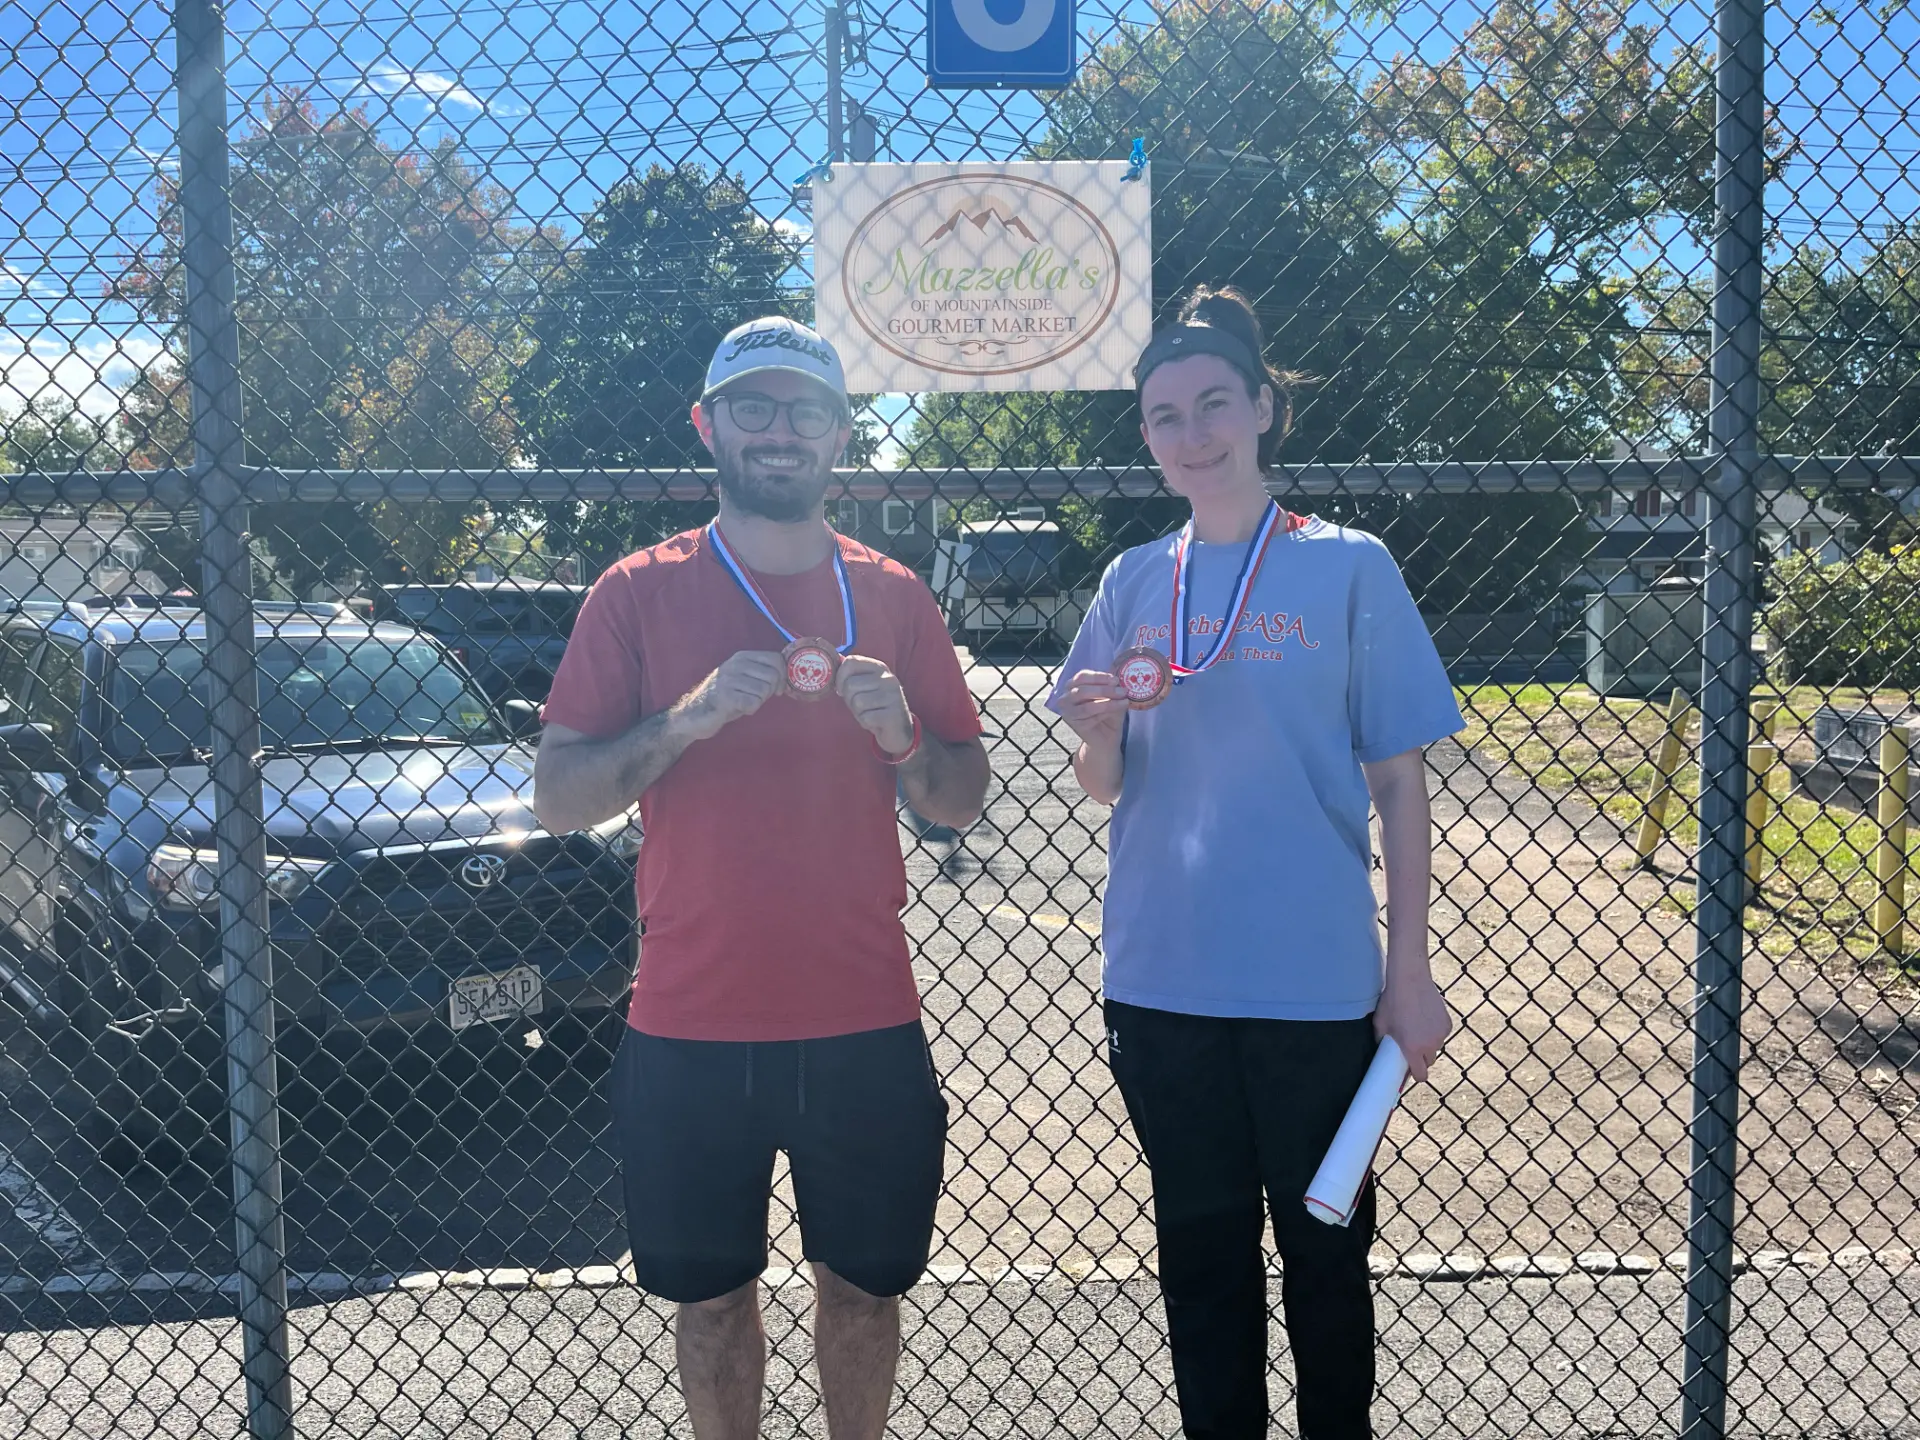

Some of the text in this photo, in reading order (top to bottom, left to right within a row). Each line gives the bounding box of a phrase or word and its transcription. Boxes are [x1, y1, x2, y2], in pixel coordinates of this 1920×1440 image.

[863, 247, 1099, 296] Mazzella's
[911, 298, 1053, 312] OF MOUNTAINSIDE
[887, 316, 1077, 335] GOURMET MARKET
[724, 327, 832, 366] Titleist
[1136, 623, 1172, 647] Roc
[1188, 613, 1225, 635] the
[1242, 647, 1284, 661] Theta
